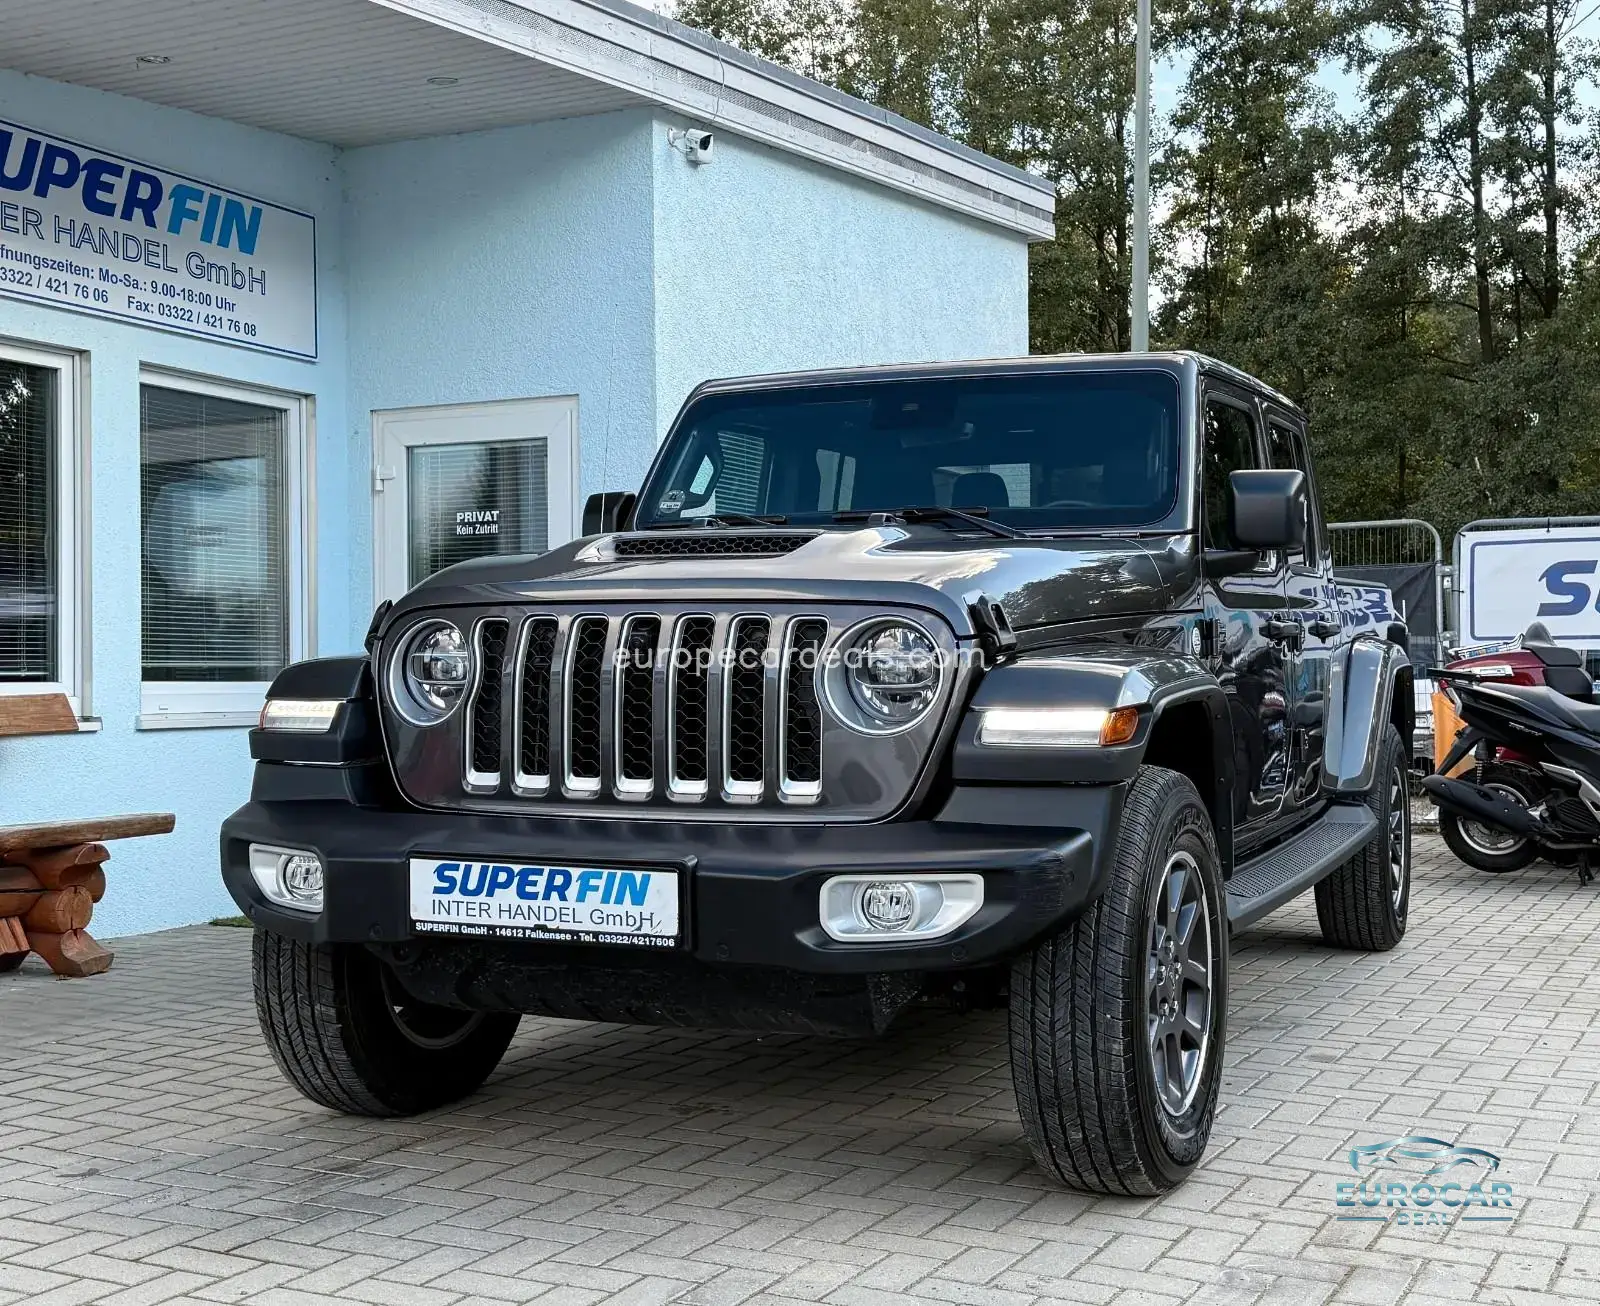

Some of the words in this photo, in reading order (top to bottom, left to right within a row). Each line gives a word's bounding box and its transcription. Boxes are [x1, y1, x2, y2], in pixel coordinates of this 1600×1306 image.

[54, 214, 179, 274] HANDEL
[186, 251, 266, 296] GmbH
[45, 277, 68, 295] 421
[73, 283, 89, 300] 76
[93, 288, 108, 303] 06
[127, 295, 154, 314] Fax:
[158, 303, 193, 323] 03322
[203, 313, 223, 329] 421
[227, 318, 241, 333] 76
[243, 322, 257, 337] 08
[98, 267, 148, 292] Mo-Sa.:
[150, 280, 212, 307] 9.00-18:00
[215, 295, 237, 312] Uhr
[456, 510, 500, 523] PRIVAT
[456, 524, 474, 535] Kein
[475, 523, 499, 534] Zutritt
[1536, 559, 1600, 617] S
[432, 862, 652, 907] SUPERFIN
[415, 922, 459, 933] SUPERFIN
[461, 925, 488, 935] GmbH
[495, 927, 524, 937] 14612
[525, 929, 572, 940] Falkensee
[579, 933, 596, 942] Tel.
[598, 934, 675, 947] 03322/4217606
[432, 899, 492, 919] INTER
[498, 903, 583, 924] HANDEL
[589, 908, 655, 930] GmbH
